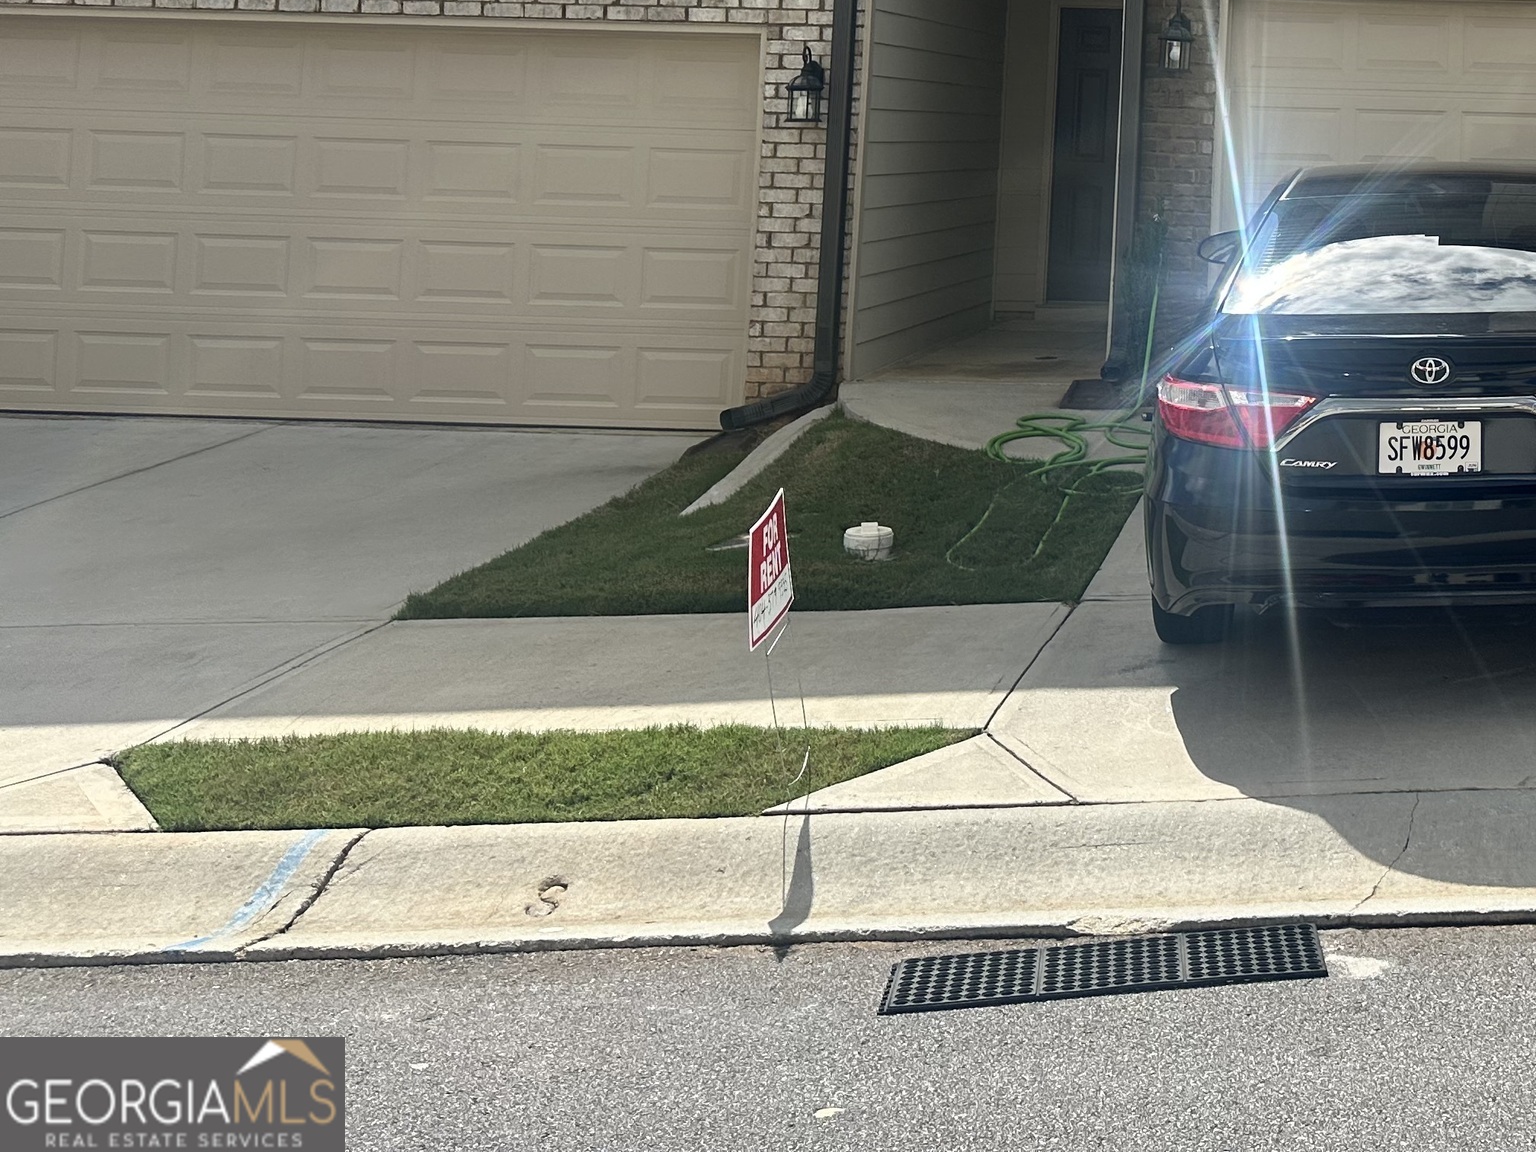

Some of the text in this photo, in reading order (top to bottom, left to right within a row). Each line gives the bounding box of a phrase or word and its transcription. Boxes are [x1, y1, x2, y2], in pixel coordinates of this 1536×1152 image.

[1402, 423, 1458, 435] GEORGIA
[1387, 434, 1470, 462] SFW8599
[763, 512, 778, 557] FOR
[760, 540, 783, 594] RENT
